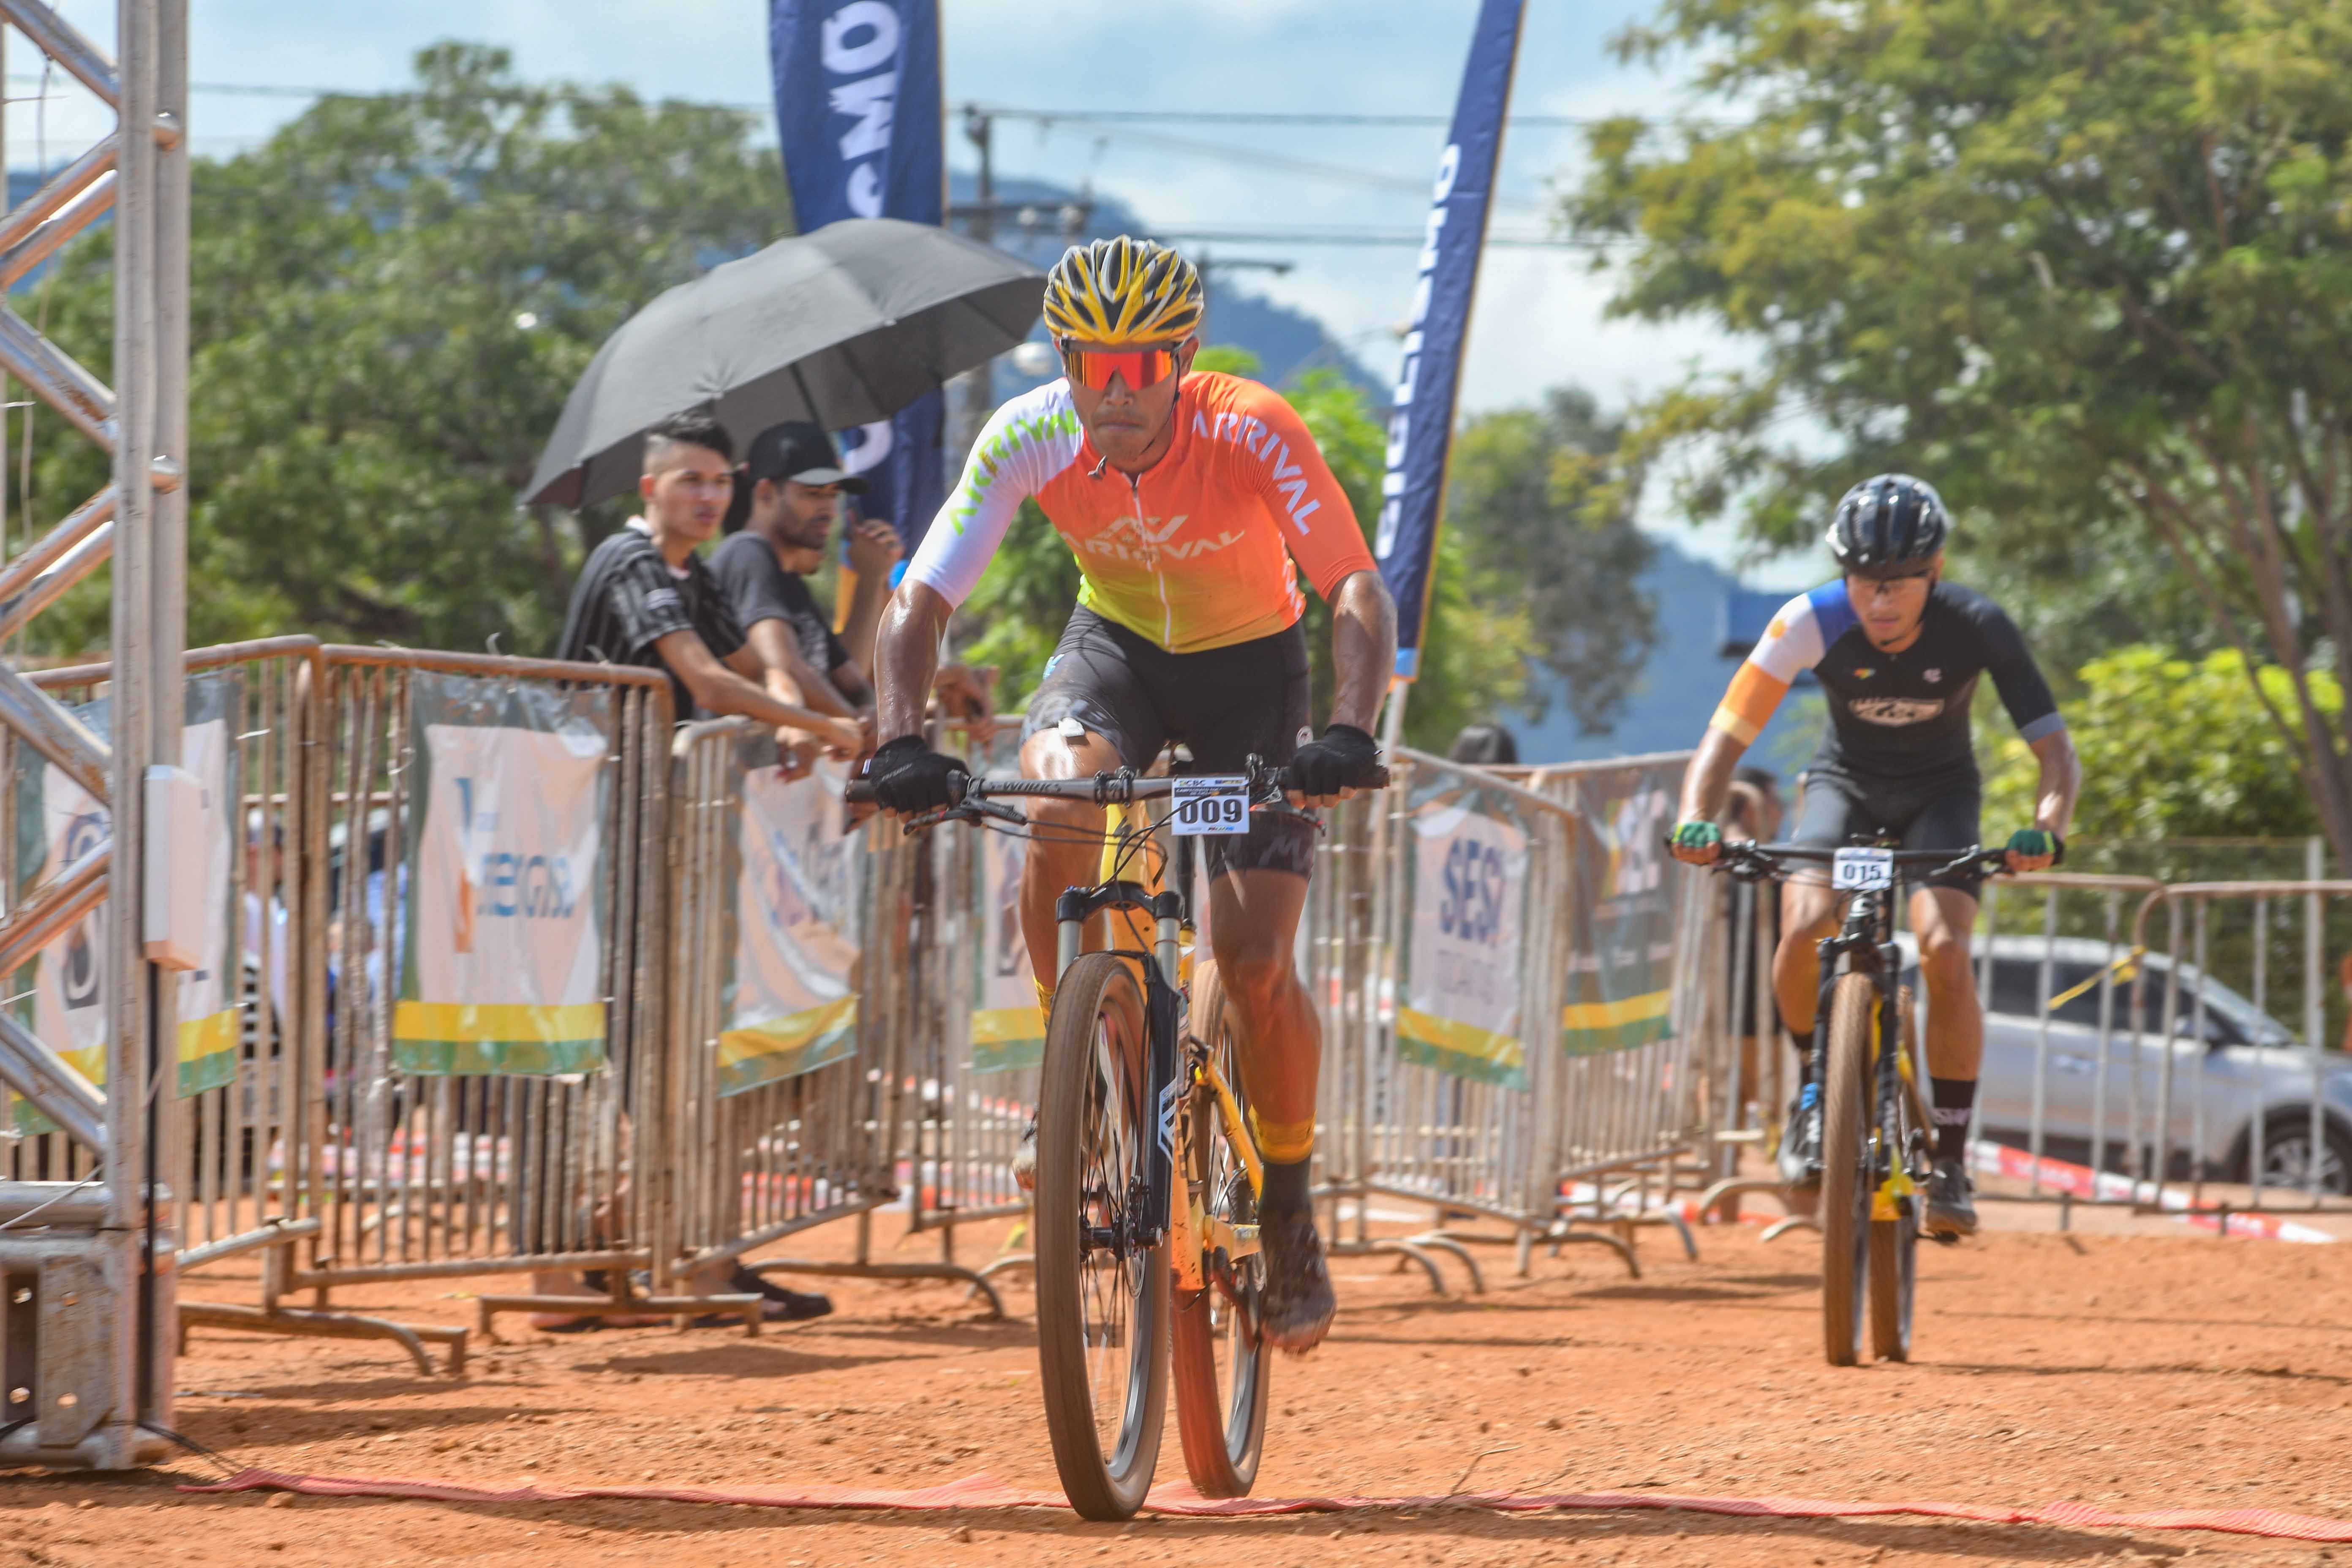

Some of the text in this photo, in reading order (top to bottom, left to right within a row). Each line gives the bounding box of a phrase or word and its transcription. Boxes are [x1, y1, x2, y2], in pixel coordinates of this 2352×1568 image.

[1191, 409, 1321, 536] ARRIVAL
[1180, 799, 1241, 824] 009
[1843, 865, 1881, 880] 015
